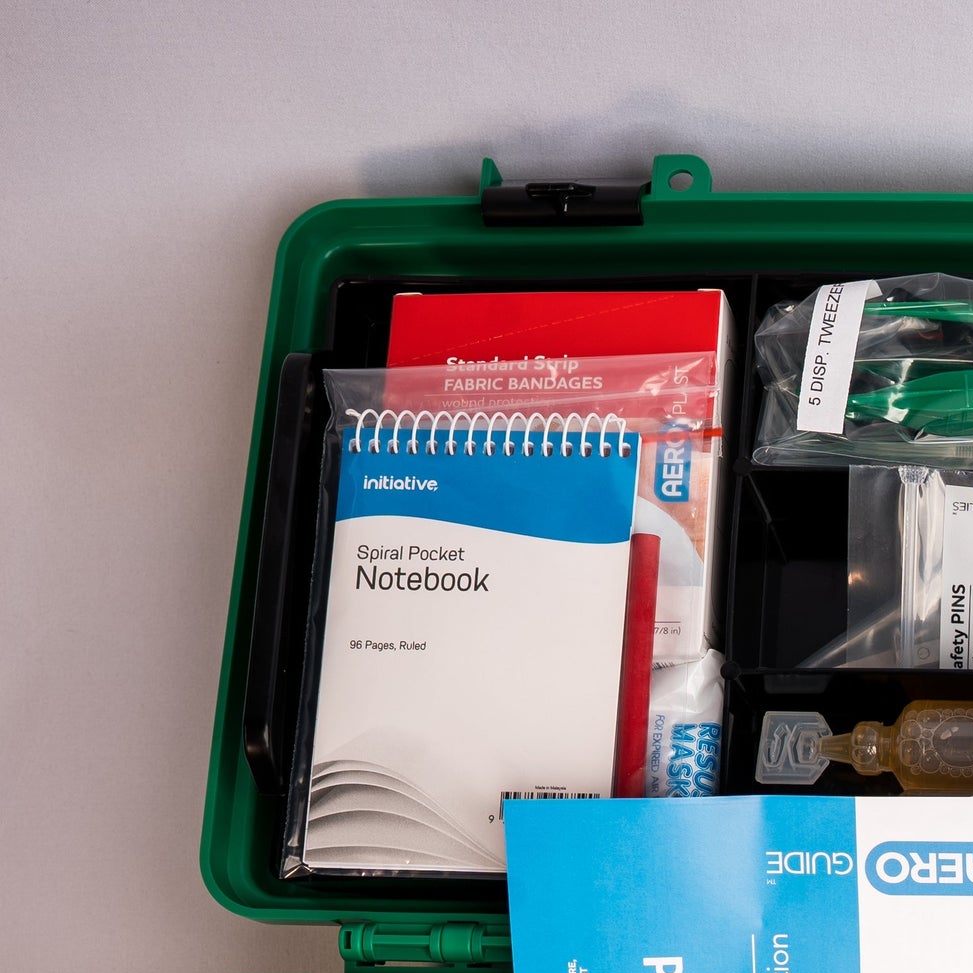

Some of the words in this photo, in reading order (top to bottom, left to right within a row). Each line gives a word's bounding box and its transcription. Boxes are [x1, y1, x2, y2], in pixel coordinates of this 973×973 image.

[446, 355, 527, 371] Standard
[534, 354, 579, 374] Strip
[810, 352, 830, 392] DISP.
[444, 378, 503, 391] FABRIC
[508, 376, 603, 390] BANDAGES
[808, 397, 821, 406] 5
[357, 545, 403, 563] Spiral
[409, 545, 465, 561] Pocket
[356, 565, 490, 591] Notebook
[951, 584, 966, 624] PINS
[350, 640, 362, 650] 96
[365, 640, 397, 652] Pages,
[399, 641, 426, 650] Ruled
[950, 629, 968, 669] afety
[666, 722, 698, 798] MASK
[693, 722, 722, 797] RESU
[488, 814, 495, 824] 9
[766, 851, 854, 876] GUIDE
